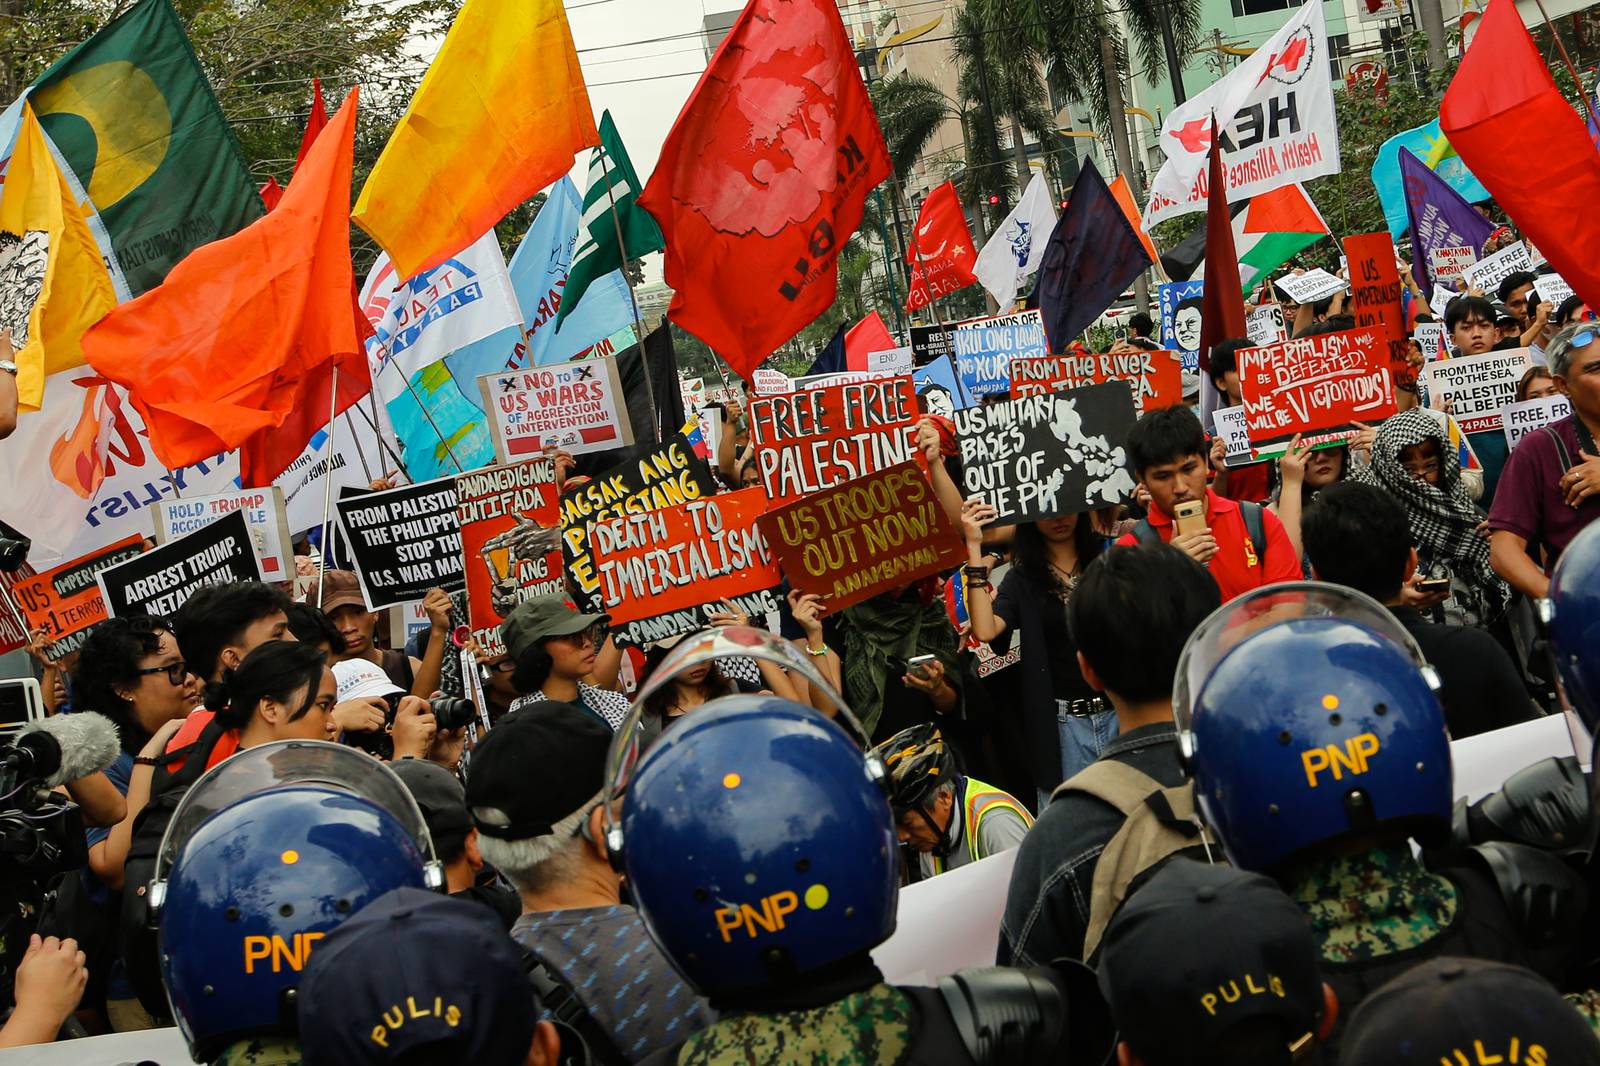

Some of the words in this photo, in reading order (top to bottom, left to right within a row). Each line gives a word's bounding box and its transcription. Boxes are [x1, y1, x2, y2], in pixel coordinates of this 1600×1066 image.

[1472, 260, 1500, 282] FREE,
[1500, 247, 1525, 266] FREE
[1021, 313, 1039, 324] OFF
[1163, 288, 1174, 340] SARA
[959, 358, 974, 375] NG
[1012, 358, 1061, 381] FROM
[1240, 334, 1350, 381] IMPERIALISM
[1433, 365, 1467, 379] FROM
[1468, 361, 1491, 373] THE
[1493, 356, 1525, 369] RIVER
[524, 371, 554, 390] NO
[557, 373, 570, 384] TO
[1257, 374, 1271, 384] BE
[1448, 376, 1464, 386] TO
[1465, 372, 1489, 383] THE
[500, 392, 528, 413] US
[537, 380, 604, 408] WARS
[1245, 393, 1276, 414] WE
[1475, 399, 1494, 411] BE
[505, 426, 513, 435] &
[517, 411, 609, 435] INTERVENTION!
[508, 412, 522, 423] OF
[527, 402, 601, 422] AGGRESSION
[750, 390, 831, 445] FREE
[843, 379, 913, 430] FREE
[954, 410, 985, 436] US
[1248, 414, 1276, 431] WILL
[1275, 410, 1292, 426] BE
[1510, 408, 1548, 424] FREE,
[639, 443, 688, 484] ANG
[760, 425, 919, 498] PALESTINE
[965, 460, 1009, 492] OUT
[1016, 450, 1045, 482] OF
[168, 502, 204, 520] HOLD
[209, 494, 265, 513] TRUMP
[346, 506, 389, 528] FROM
[390, 491, 458, 520] PALESTIN
[459, 487, 545, 525] INTIFADA
[777, 506, 820, 546] US
[816, 468, 925, 530] TROOPS
[361, 527, 391, 546] THE
[596, 511, 668, 556] DEATH
[686, 501, 721, 537] TO
[803, 528, 858, 577] OUT
[861, 501, 939, 556] NOW!
[396, 540, 434, 562] STOP
[125, 562, 188, 605] ARREST
[188, 535, 242, 576] TRUMP,
[370, 570, 399, 587] U.S.
[398, 562, 435, 584] WAR
[520, 557, 548, 584] ANG
[20, 583, 50, 612] US
[1301, 732, 1380, 787] PNP
[714, 890, 799, 943] PNP
[370, 995, 463, 1049] PULIS
